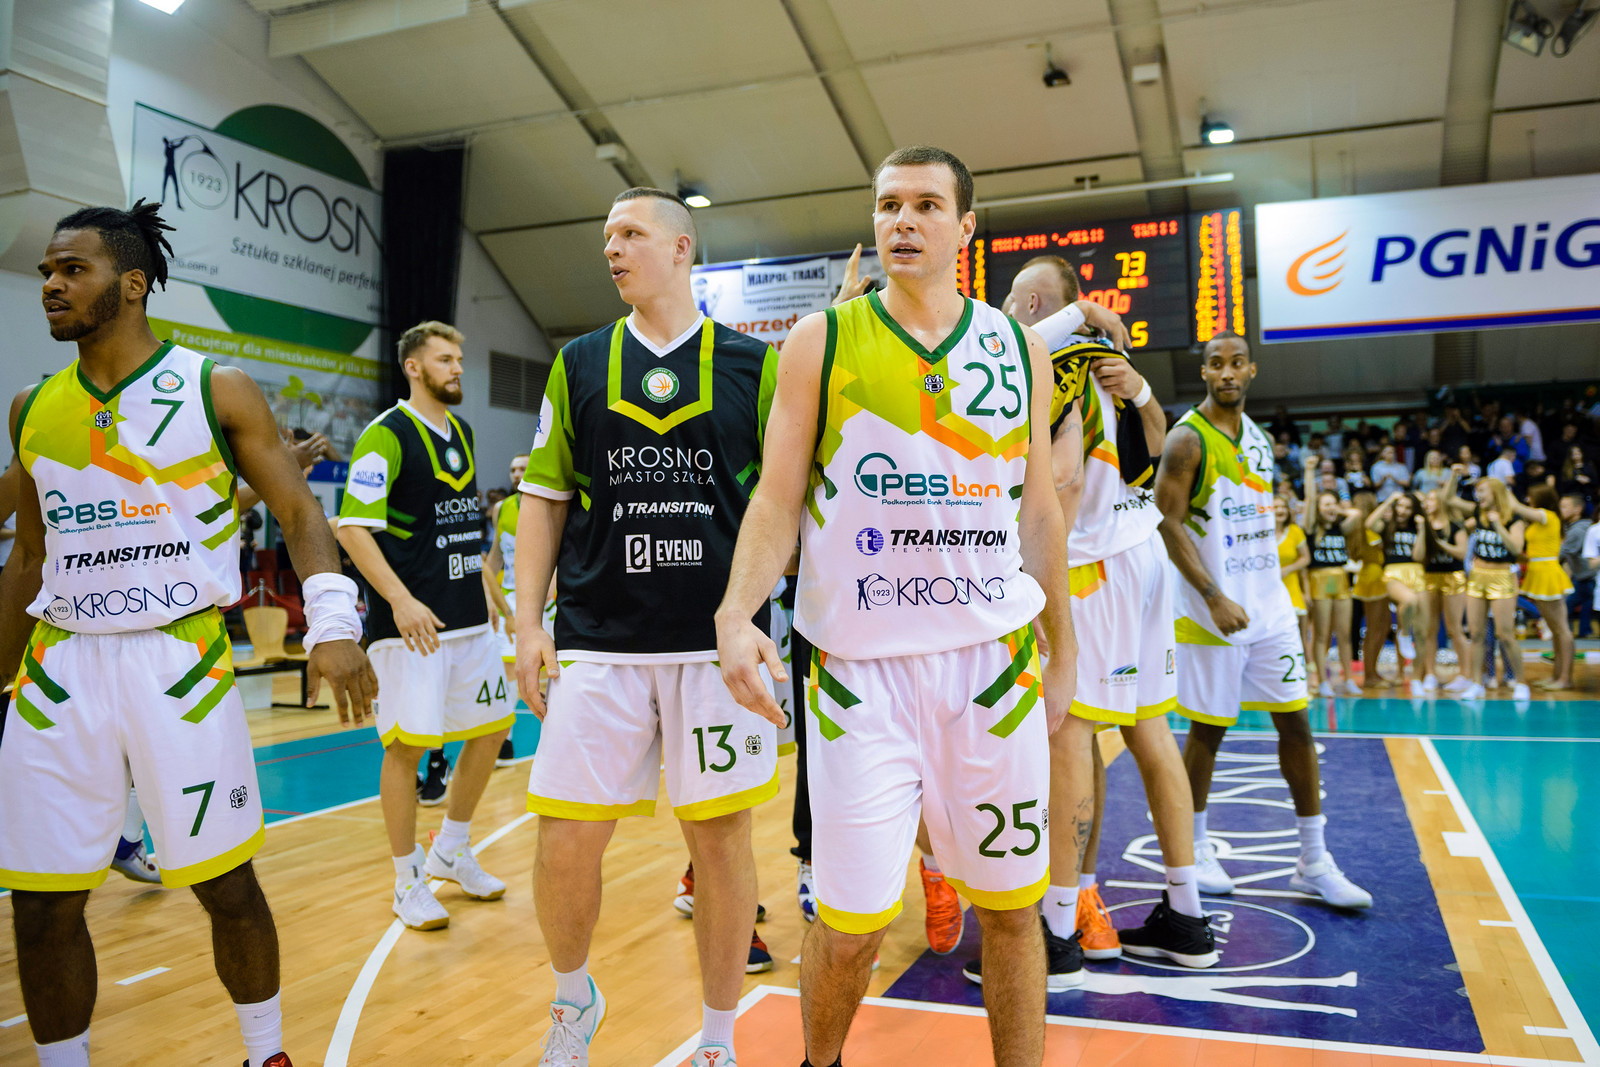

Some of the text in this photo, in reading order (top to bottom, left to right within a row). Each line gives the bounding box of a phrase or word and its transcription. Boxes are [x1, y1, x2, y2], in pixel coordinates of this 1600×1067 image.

[231, 236, 278, 264] Sztuka
[283, 254, 335, 280] szklanej
[1371, 217, 1600, 282] PGNiG
[793, 265, 825, 281] TRANS
[1080, 263, 1094, 280] 4
[1115, 251, 1147, 277] 73
[172, 329, 241, 358] Pracujemy
[243, 342, 261, 357] dla
[963, 361, 1022, 419] 25
[146, 398, 185, 447] 7
[607, 446, 713, 471] KROSNO
[609, 471, 715, 486] MIASTO SZKŁA
[881, 473, 1003, 498] PBSban
[627, 502, 715, 516] TRANSITION
[881, 498, 925, 507] Podkarpacki
[96, 522, 112, 530] Bank
[890, 529, 1007, 546] TRANSITION
[63, 541, 190, 570] TRANSITION
[656, 539, 703, 561] EVEND
[65, 557, 190, 576] TECHNOLOGIES
[53, 582, 198, 620] 1923 KROSNO
[872, 577, 1005, 606] 1923 KROSNO
[476, 676, 507, 706] 44
[691, 724, 737, 774] 13
[182, 780, 216, 837] 7
[975, 799, 1041, 858] 25
